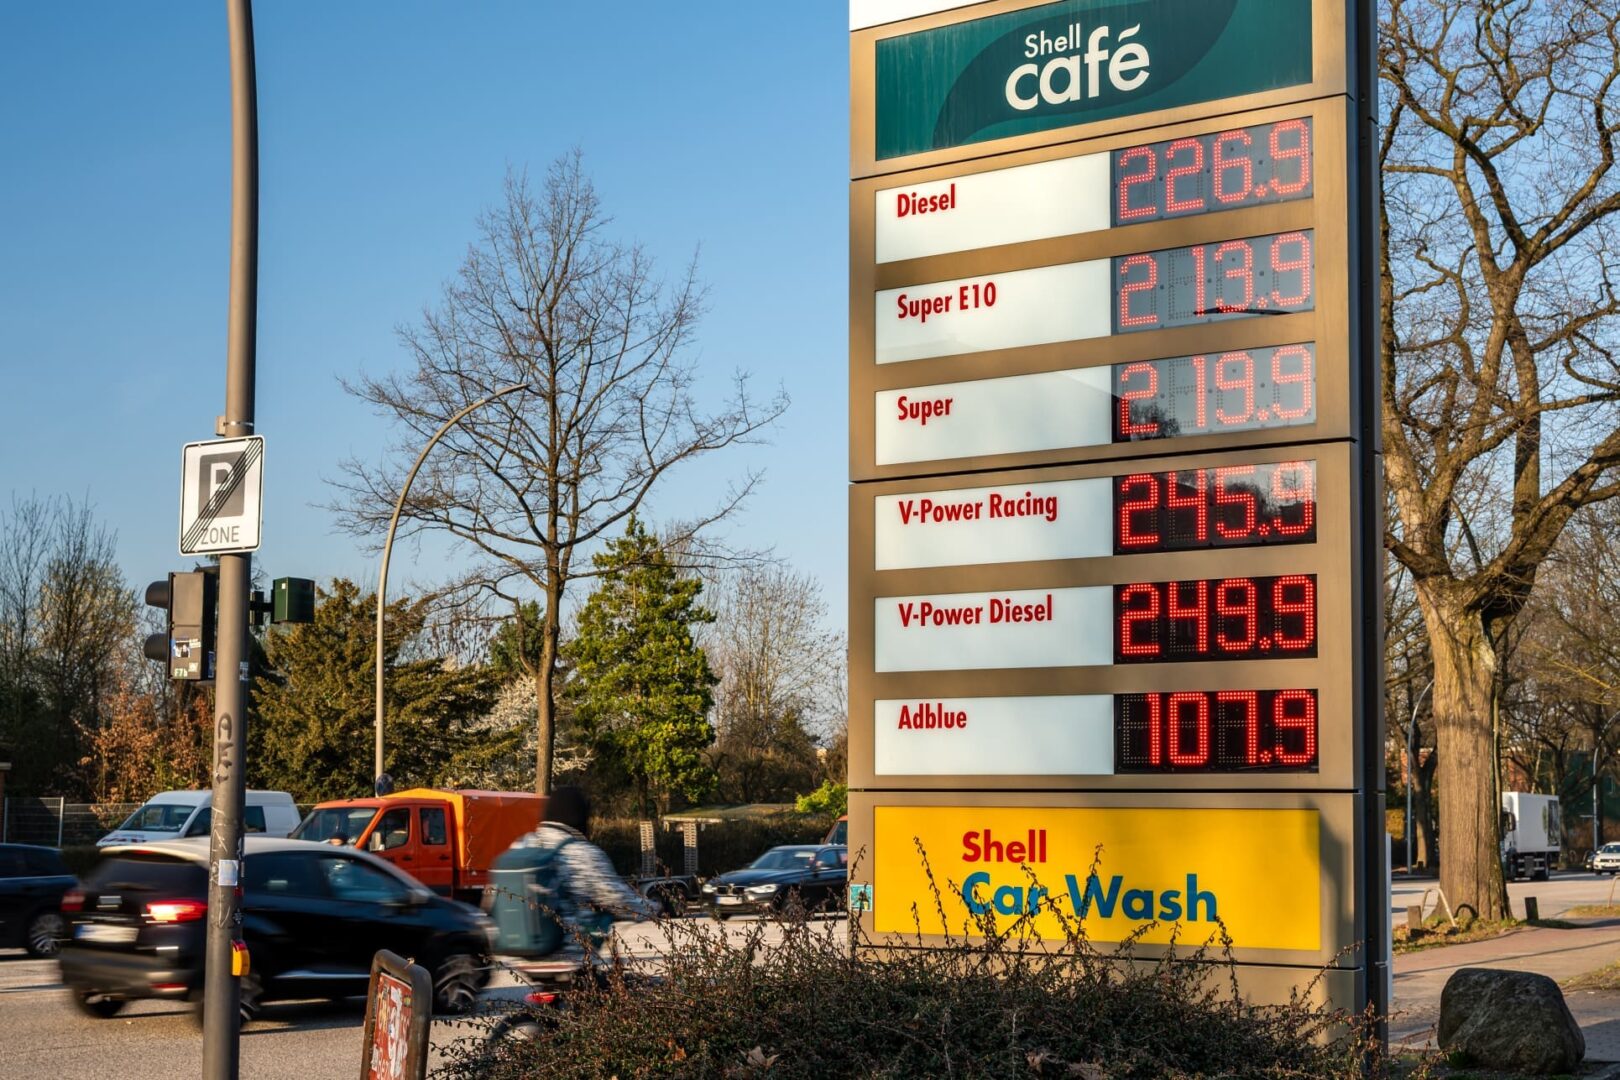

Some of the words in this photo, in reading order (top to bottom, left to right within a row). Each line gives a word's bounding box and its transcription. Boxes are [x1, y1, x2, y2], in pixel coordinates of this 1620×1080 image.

[1024, 23, 1081, 58] Shell
[1005, 24, 1150, 110] café
[1119, 119, 1310, 220] 226.9
[896, 184, 956, 218] Diesel
[1120, 232, 1311, 328] 213.9
[897, 294, 952, 324] Super
[959, 282, 997, 310] E10
[897, 396, 953, 426] Super
[1121, 344, 1312, 436] 219.9
[898, 498, 984, 525] V-Power
[989, 491, 1058, 522] Racing
[1120, 460, 1314, 547] 245.9
[201, 525, 241, 545] ZONE
[898, 601, 983, 627] V-Power
[989, 595, 1053, 624] Diesel
[1121, 574, 1315, 656] 249.9
[898, 704, 968, 730] Adblue
[1147, 689, 1316, 765] 107.9
[961, 828, 1048, 864] Shell
[962, 871, 1047, 916] Car
[1065, 873, 1217, 922] Wash
